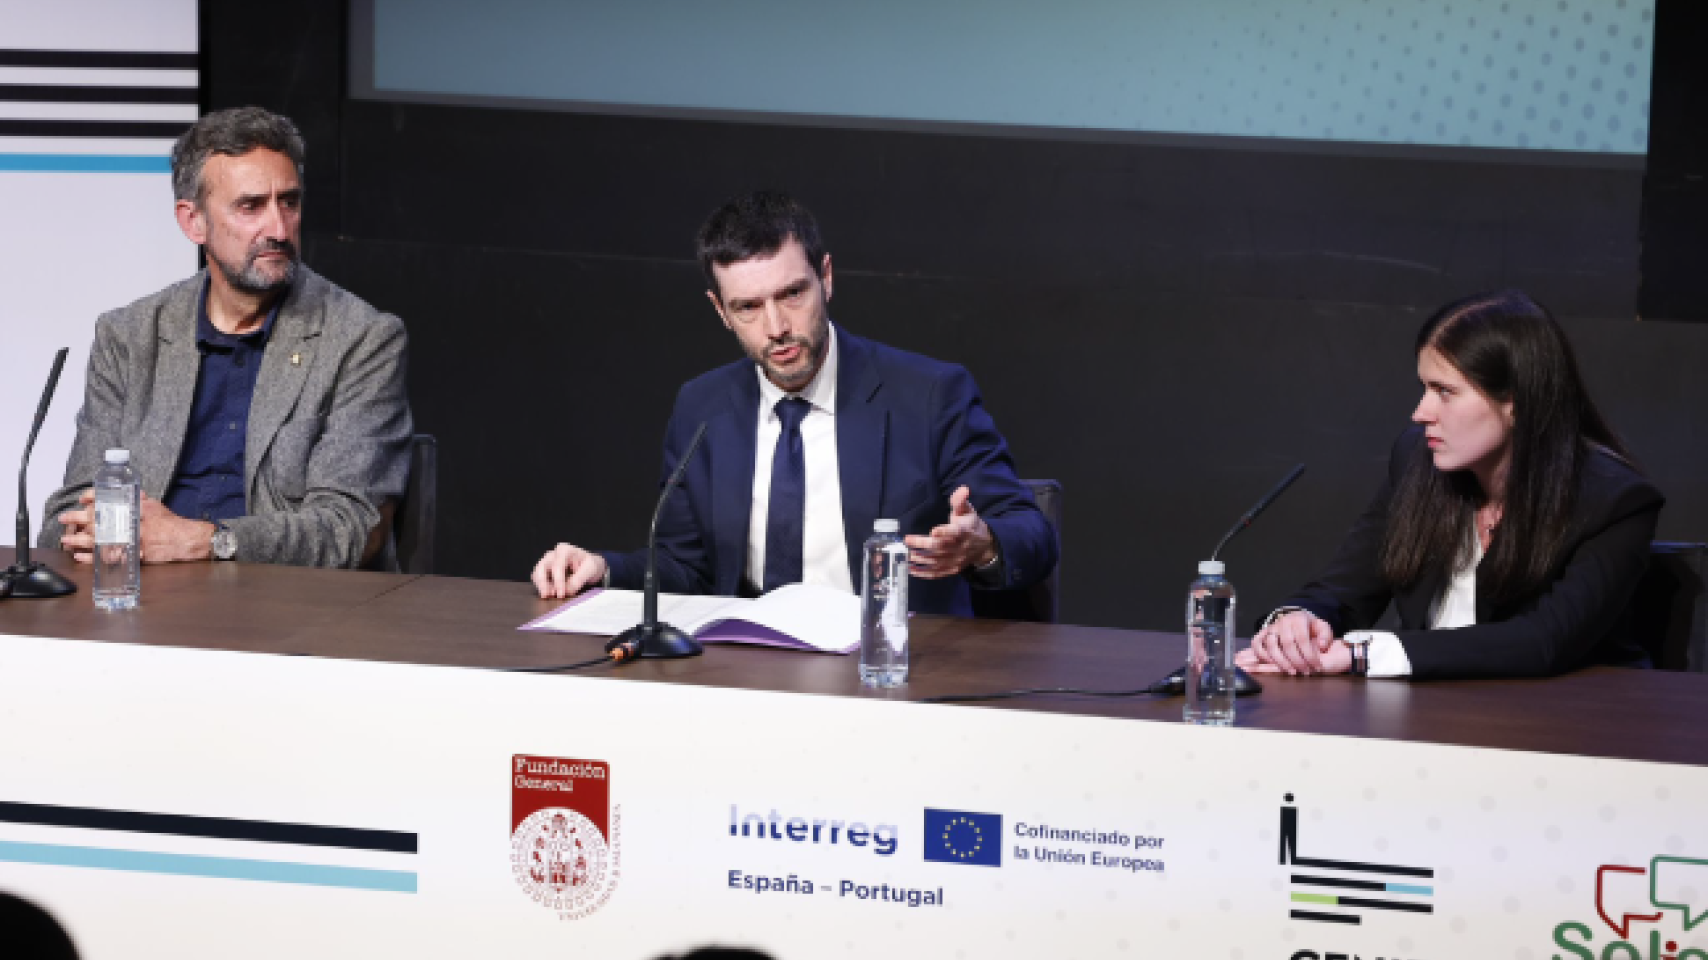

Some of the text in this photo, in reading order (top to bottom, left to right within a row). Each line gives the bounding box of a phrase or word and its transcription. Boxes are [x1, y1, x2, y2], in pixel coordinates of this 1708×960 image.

[514, 756, 605, 779] Fundación
[729, 803, 898, 856] Interreg
[1014, 822, 1164, 850] Cofinanciado por
[1014, 845, 1164, 873] la Unión Europea
[728, 869, 814, 894] España
[839, 879, 943, 907] Portugal
